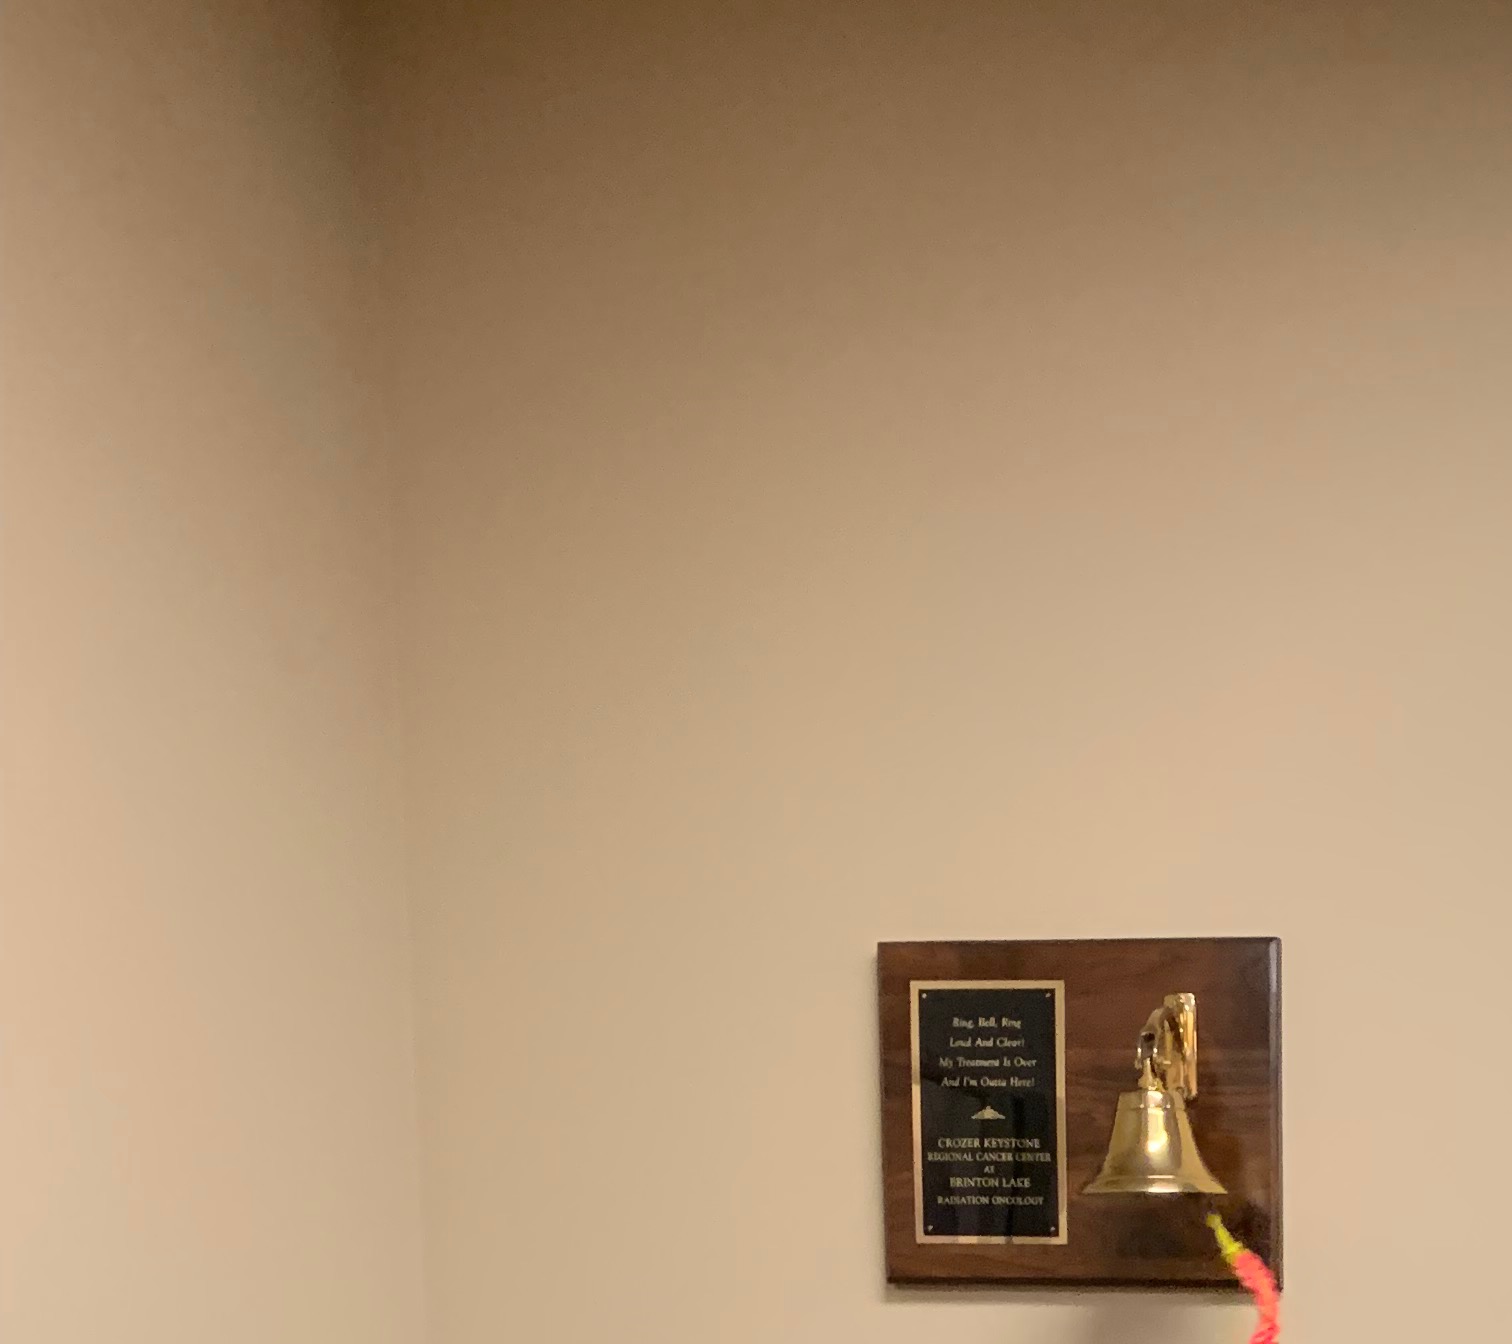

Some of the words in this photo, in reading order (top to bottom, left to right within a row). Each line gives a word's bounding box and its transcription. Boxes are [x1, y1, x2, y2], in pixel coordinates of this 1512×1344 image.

[950, 1036, 971, 1047] Loud
[975, 1037, 994, 1047] And
[940, 1057, 953, 1068] My
[956, 1056, 999, 1067] Treatment
[1003, 1056, 1011, 1067] Is
[1014, 1057, 1037, 1067] Over
[941, 1076, 960, 1087] And
[963, 1076, 978, 1087] I'm
[937, 1137, 981, 1148] CROZER
[983, 1137, 1041, 1149] KEYSTONE
[927, 1151, 974, 1161] REGIONAL
[976, 1152, 1013, 1161] CANCER
[1015, 1152, 1051, 1162] CENTER
[949, 1177, 999, 1187] BRINTON
[1001, 1177, 1031, 1188] LAKE
[937, 1195, 990, 1205] RADIATION
[991, 1195, 1044, 1205] ONCOLOGY
